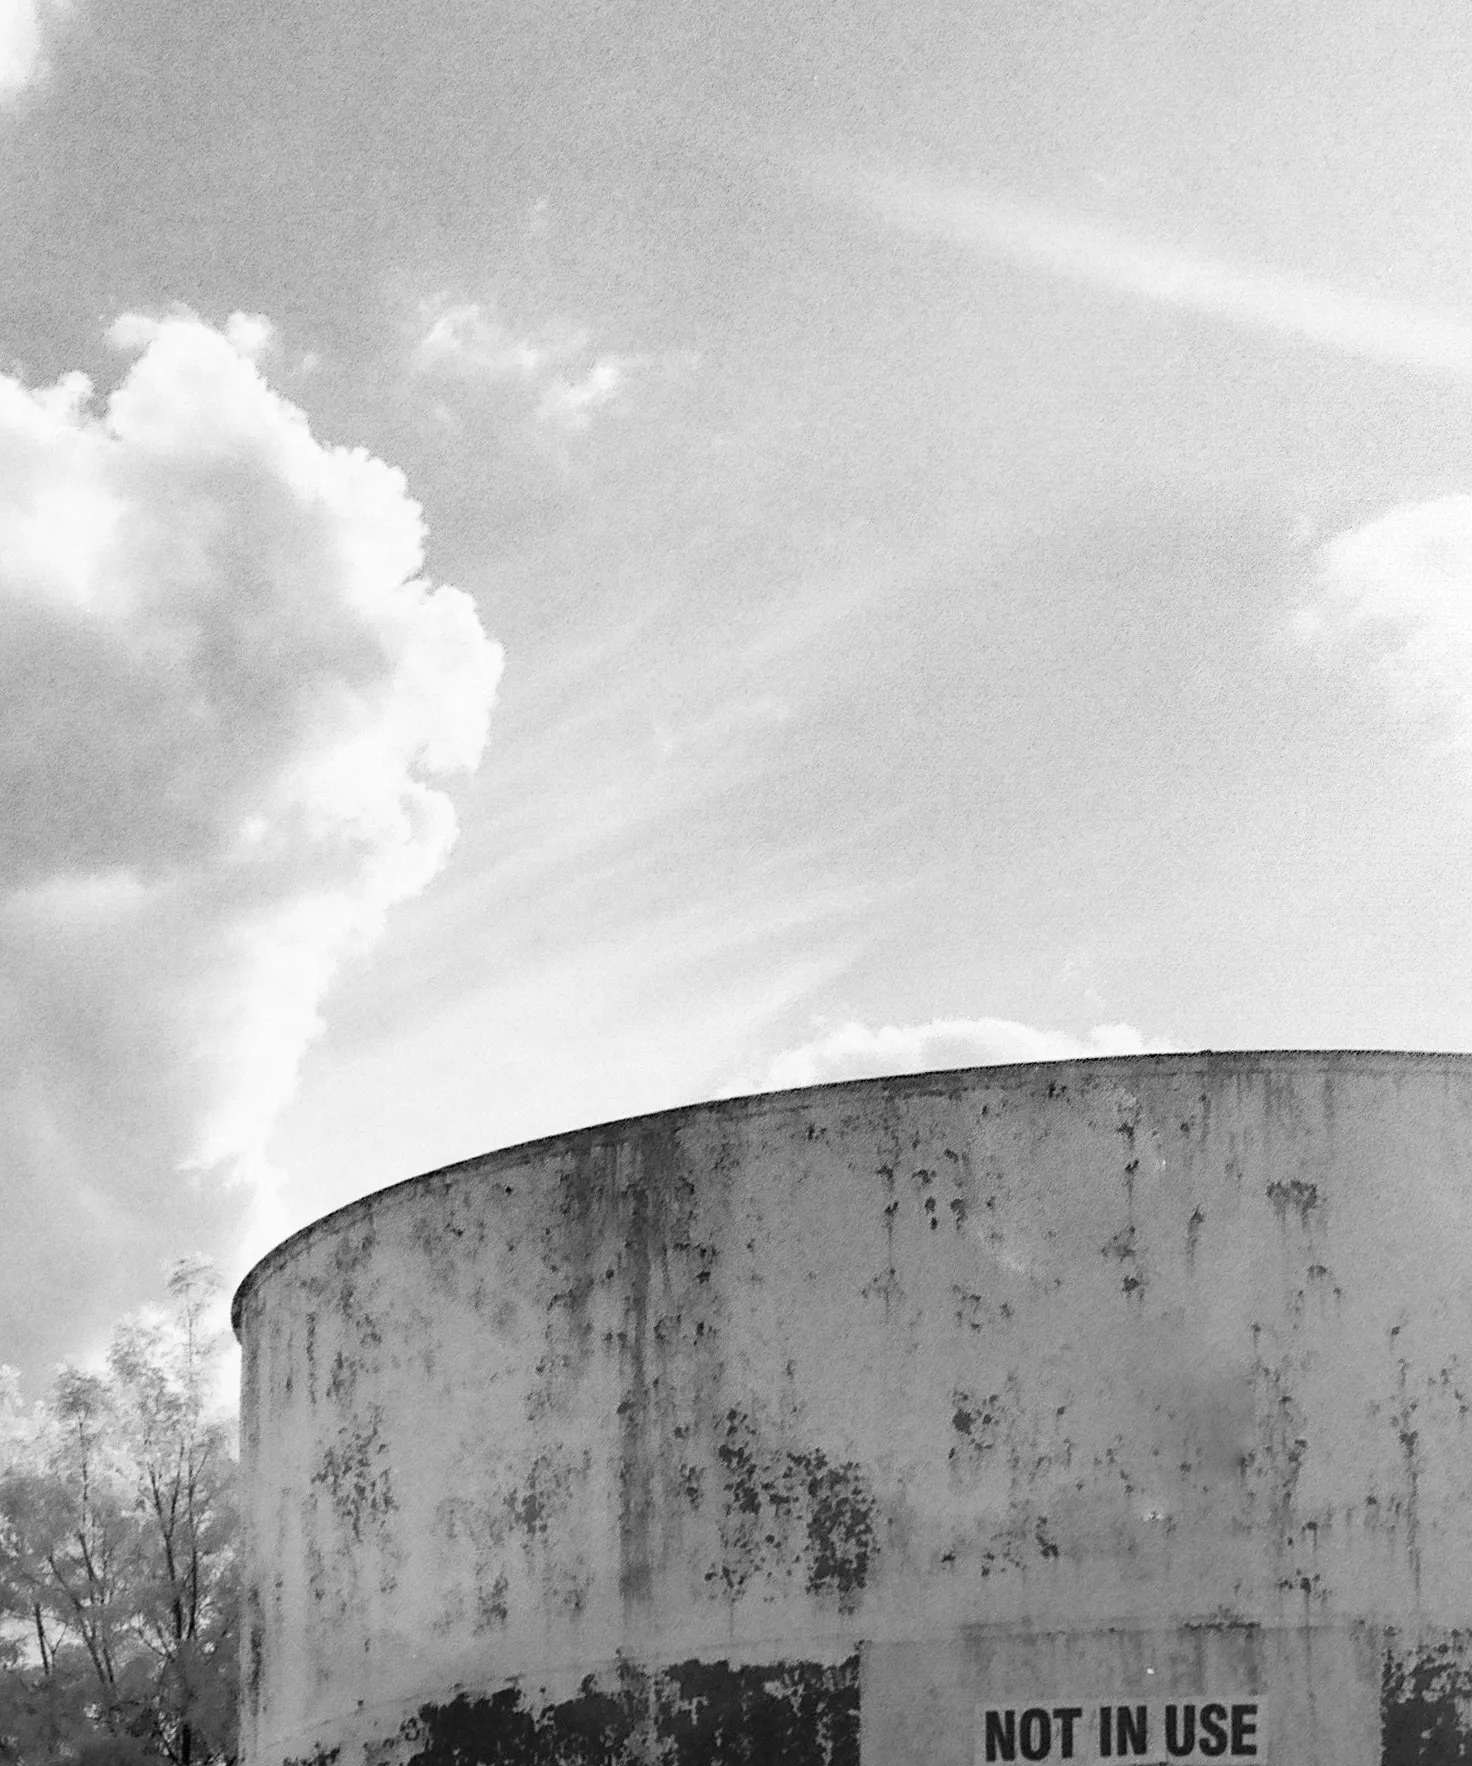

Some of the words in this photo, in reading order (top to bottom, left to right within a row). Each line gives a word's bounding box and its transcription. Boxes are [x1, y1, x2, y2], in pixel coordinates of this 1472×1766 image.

[984, 1706, 1083, 1763] NOT
[1099, 1705, 1148, 1758] IN
[1164, 1703, 1258, 1757] USE
